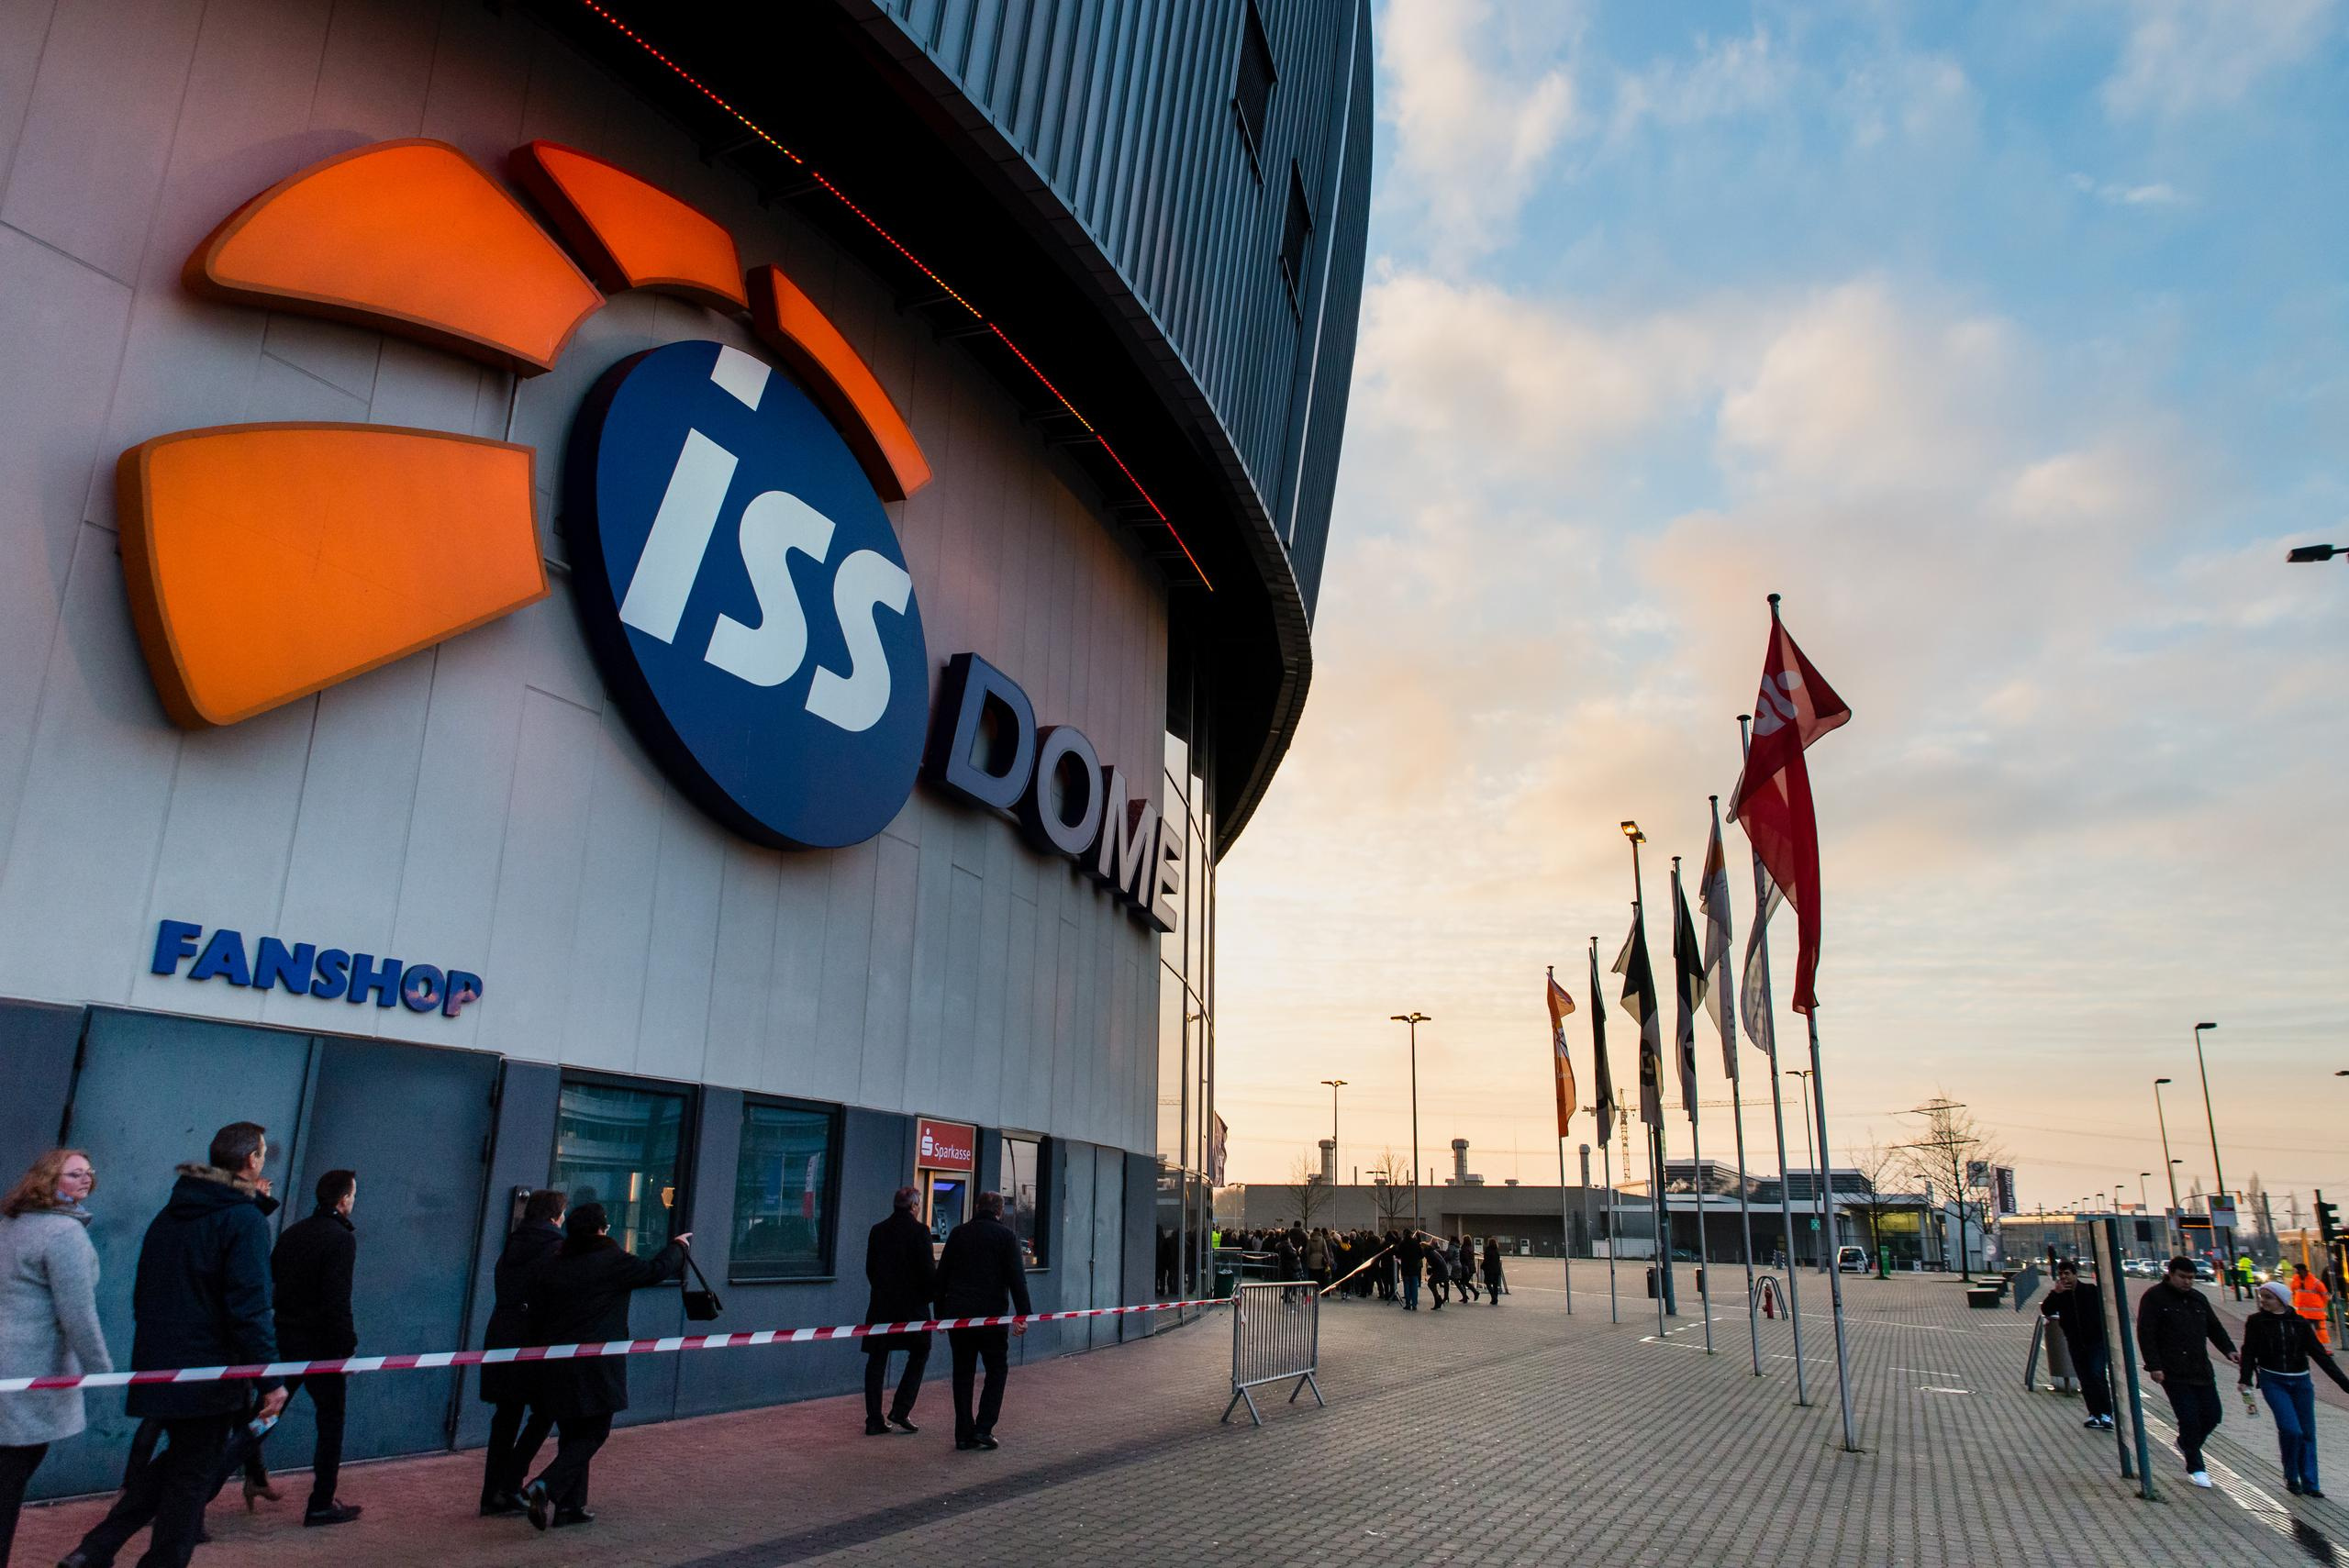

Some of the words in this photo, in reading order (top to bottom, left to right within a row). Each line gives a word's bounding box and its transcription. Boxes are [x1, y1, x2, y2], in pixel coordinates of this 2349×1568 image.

[927, 652, 1184, 932] DOME
[151, 919, 484, 1018] FANSHOP
[934, 1142, 971, 1161] Sparkasse
